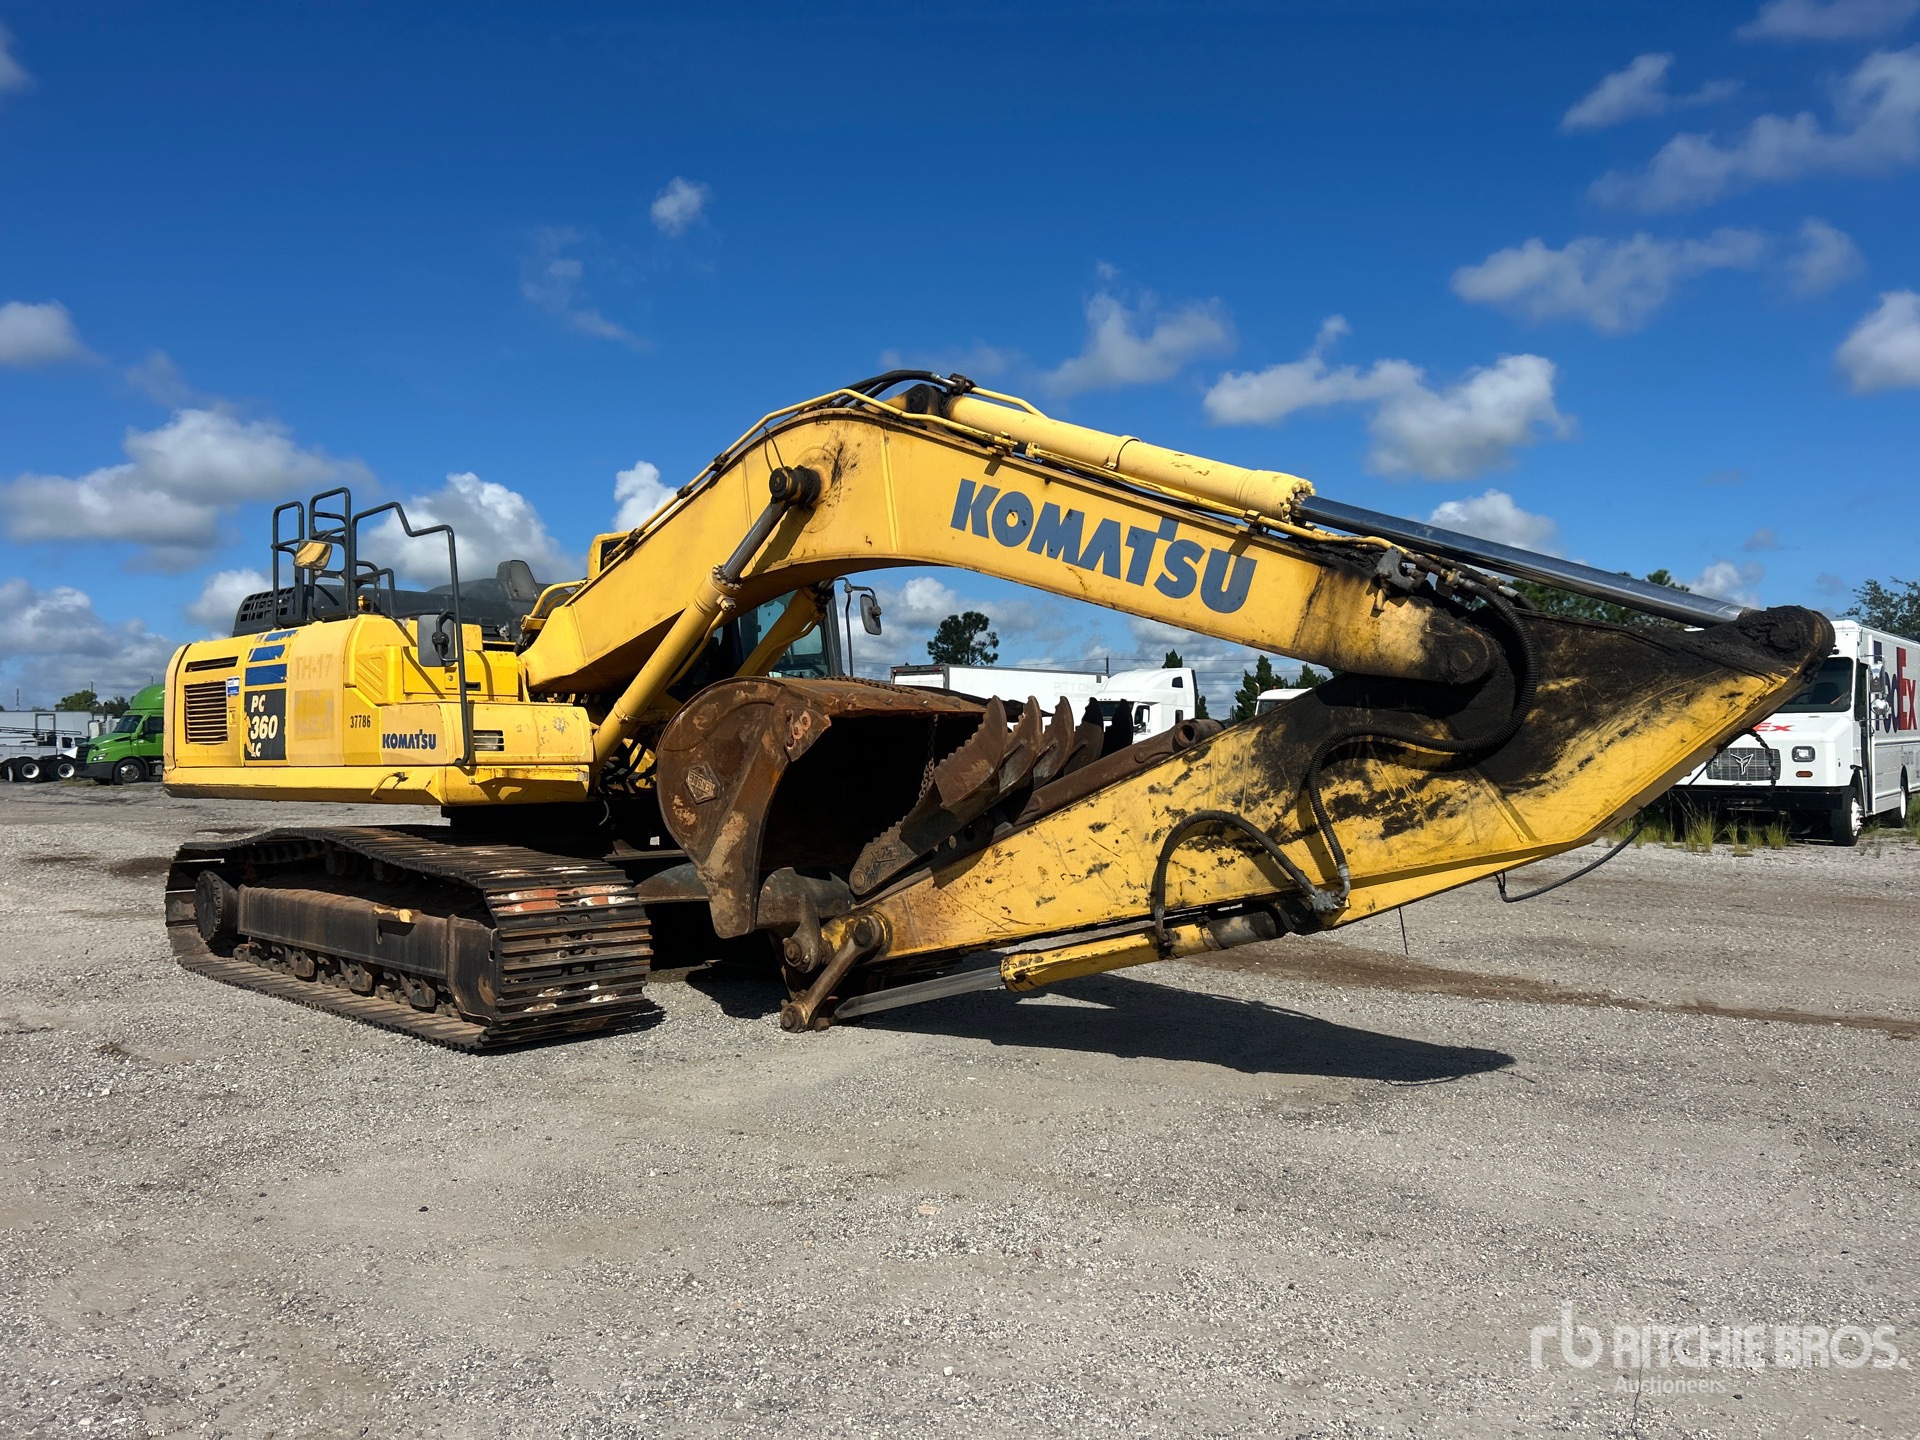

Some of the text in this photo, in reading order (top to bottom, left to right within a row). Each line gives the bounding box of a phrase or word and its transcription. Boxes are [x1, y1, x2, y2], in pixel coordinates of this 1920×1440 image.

[950, 478, 1258, 614] KOMATSU
[1873, 640, 1918, 734] edEx
[250, 694, 266, 713] PC
[250, 715, 279, 740] 360
[350, 715, 371, 728] 37786
[250, 742, 262, 758] LC
[382, 729, 437, 750] KOMATSU
